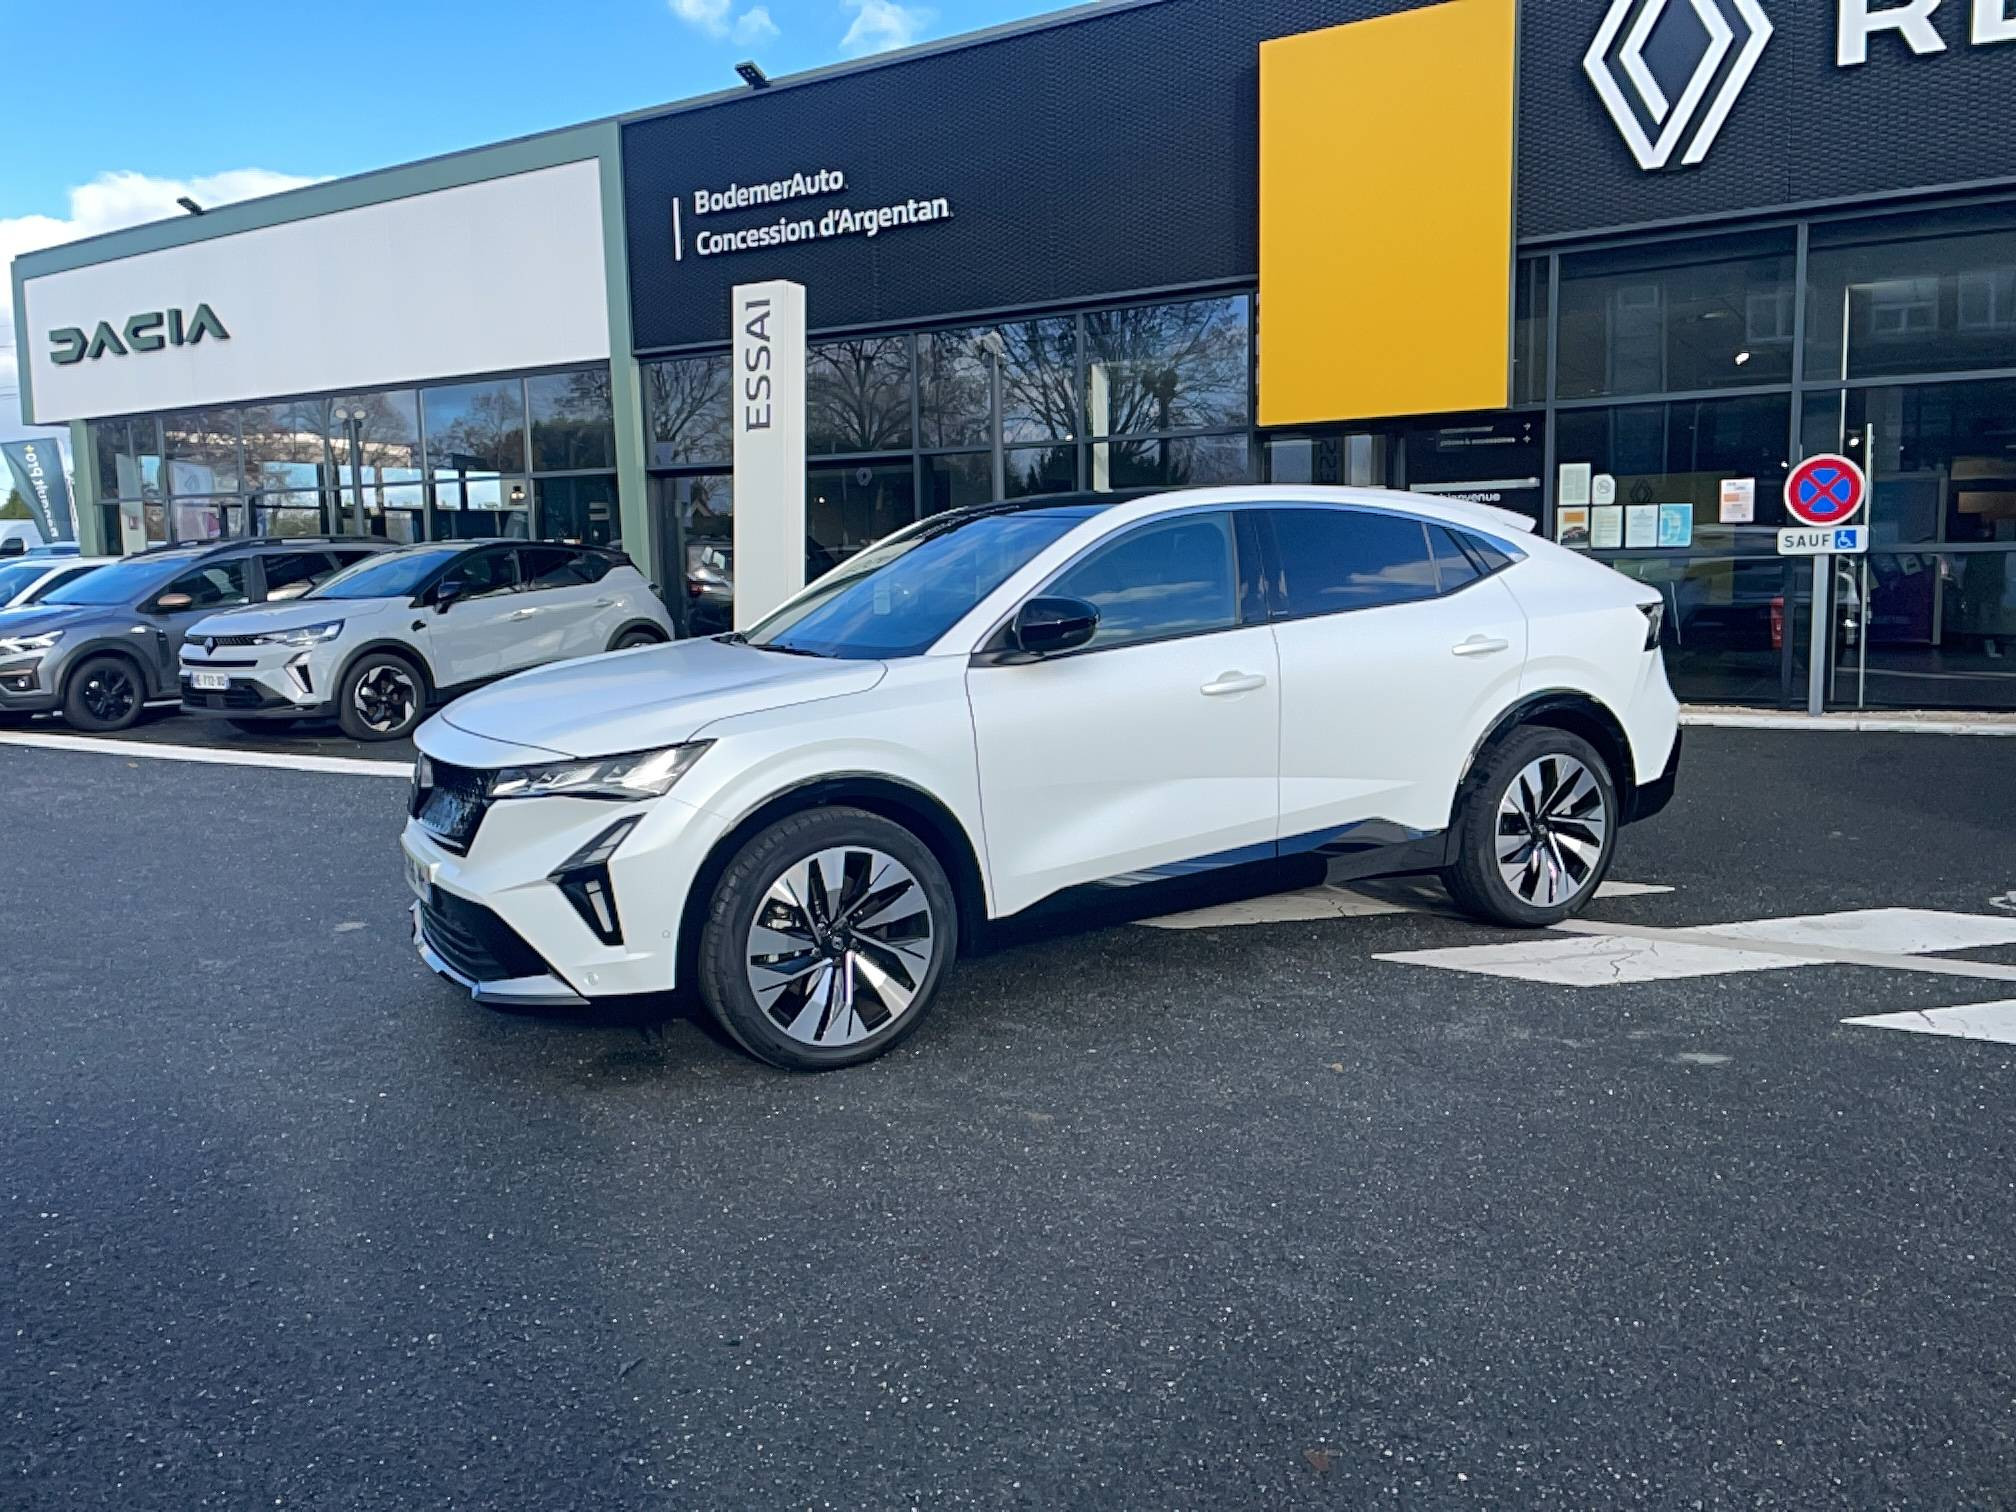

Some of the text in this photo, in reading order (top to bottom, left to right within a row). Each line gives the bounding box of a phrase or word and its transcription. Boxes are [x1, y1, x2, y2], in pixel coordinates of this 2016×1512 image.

[694, 169, 844, 214] BodemerAuto
[696, 197, 950, 255] Concession d'Argentan
[49, 303, 230, 365] DACIA
[745, 298, 771, 432] ESSAI
[1784, 533, 1831, 548] SAUF
